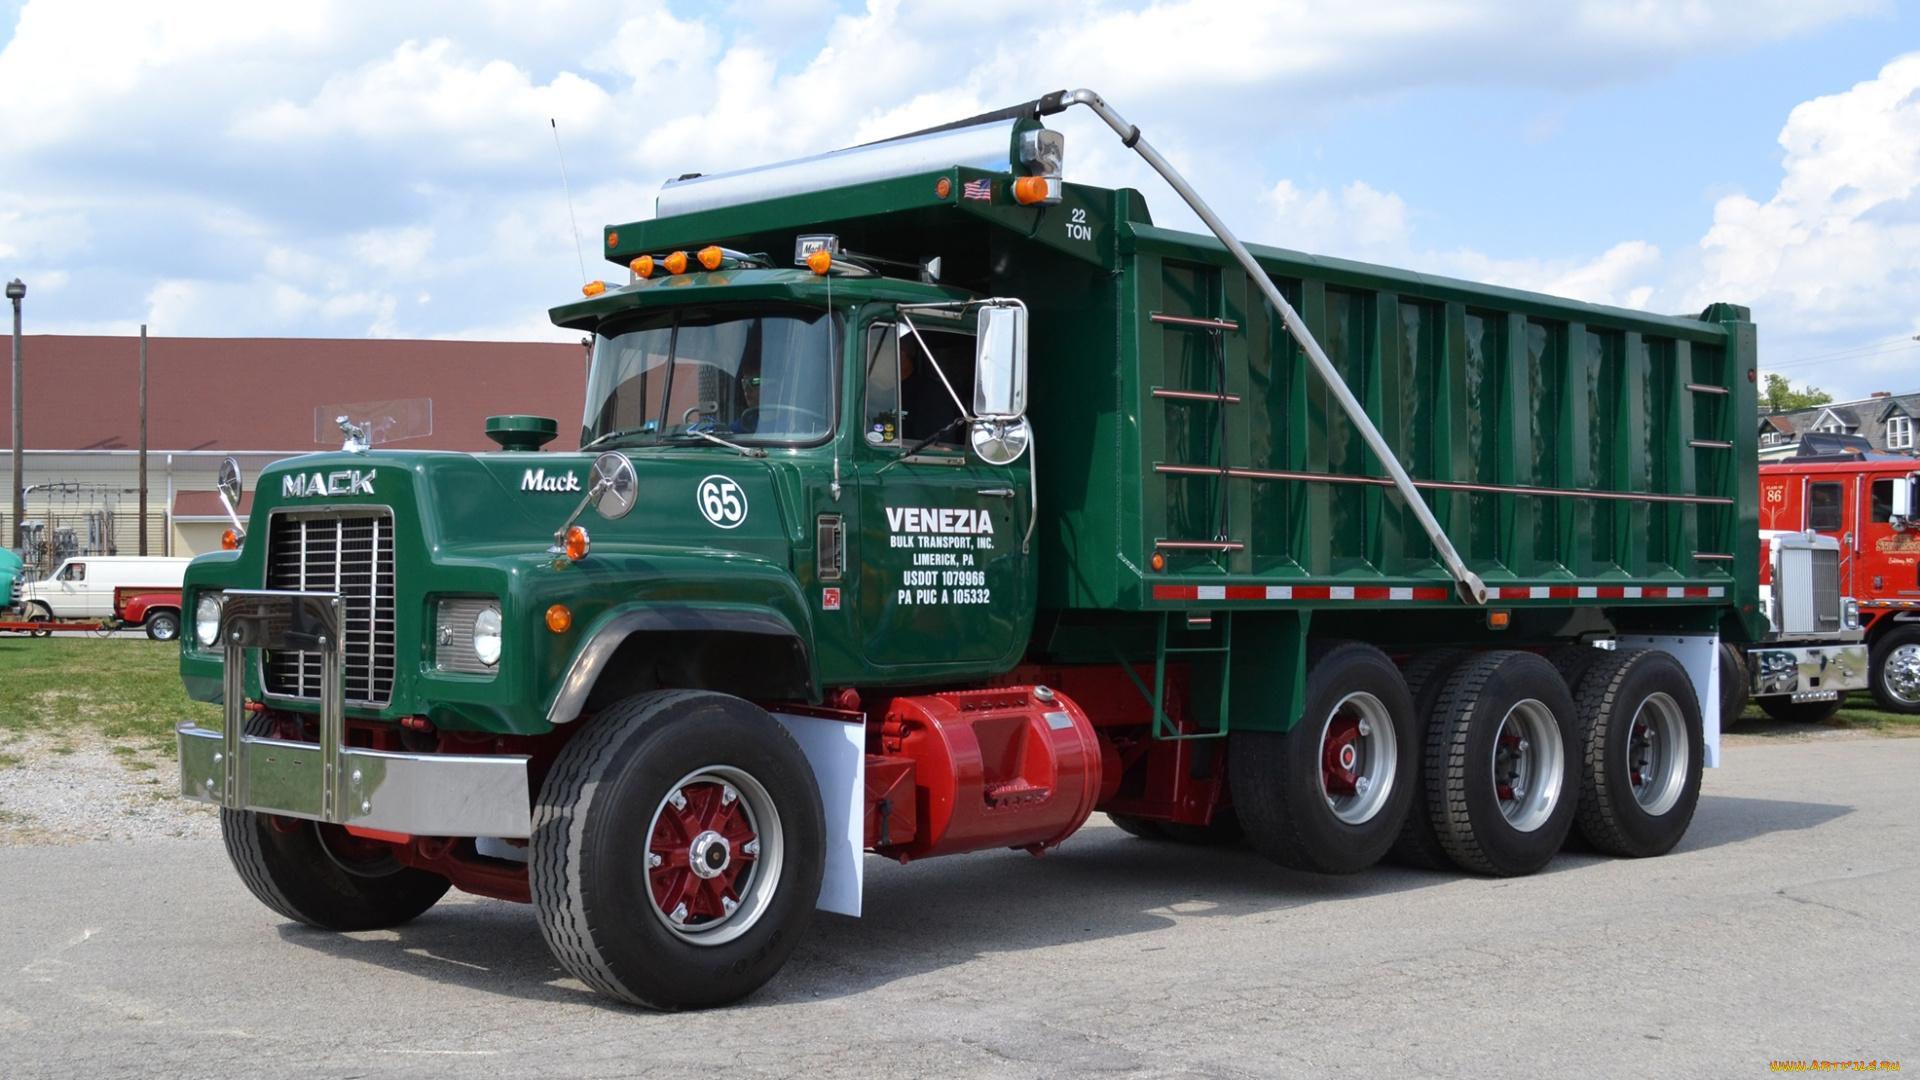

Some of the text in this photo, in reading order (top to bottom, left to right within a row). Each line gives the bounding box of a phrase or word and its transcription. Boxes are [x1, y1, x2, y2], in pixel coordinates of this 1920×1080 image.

[1072, 208, 1086, 223] 22
[1065, 223, 1091, 241] TON
[282, 468, 377, 498] MACK
[521, 467, 582, 492] Mack
[703, 482, 741, 522] 65
[1767, 490, 1781, 502] 86
[886, 507, 994, 534] VENEZIA
[890, 536, 995, 550] BULK TRANSPORT, INC.
[913, 553, 974, 568] LIMERICK, PA
[904, 571, 985, 586] USDOT 1079966
[898, 589, 990, 604] PA PUC A 105332
